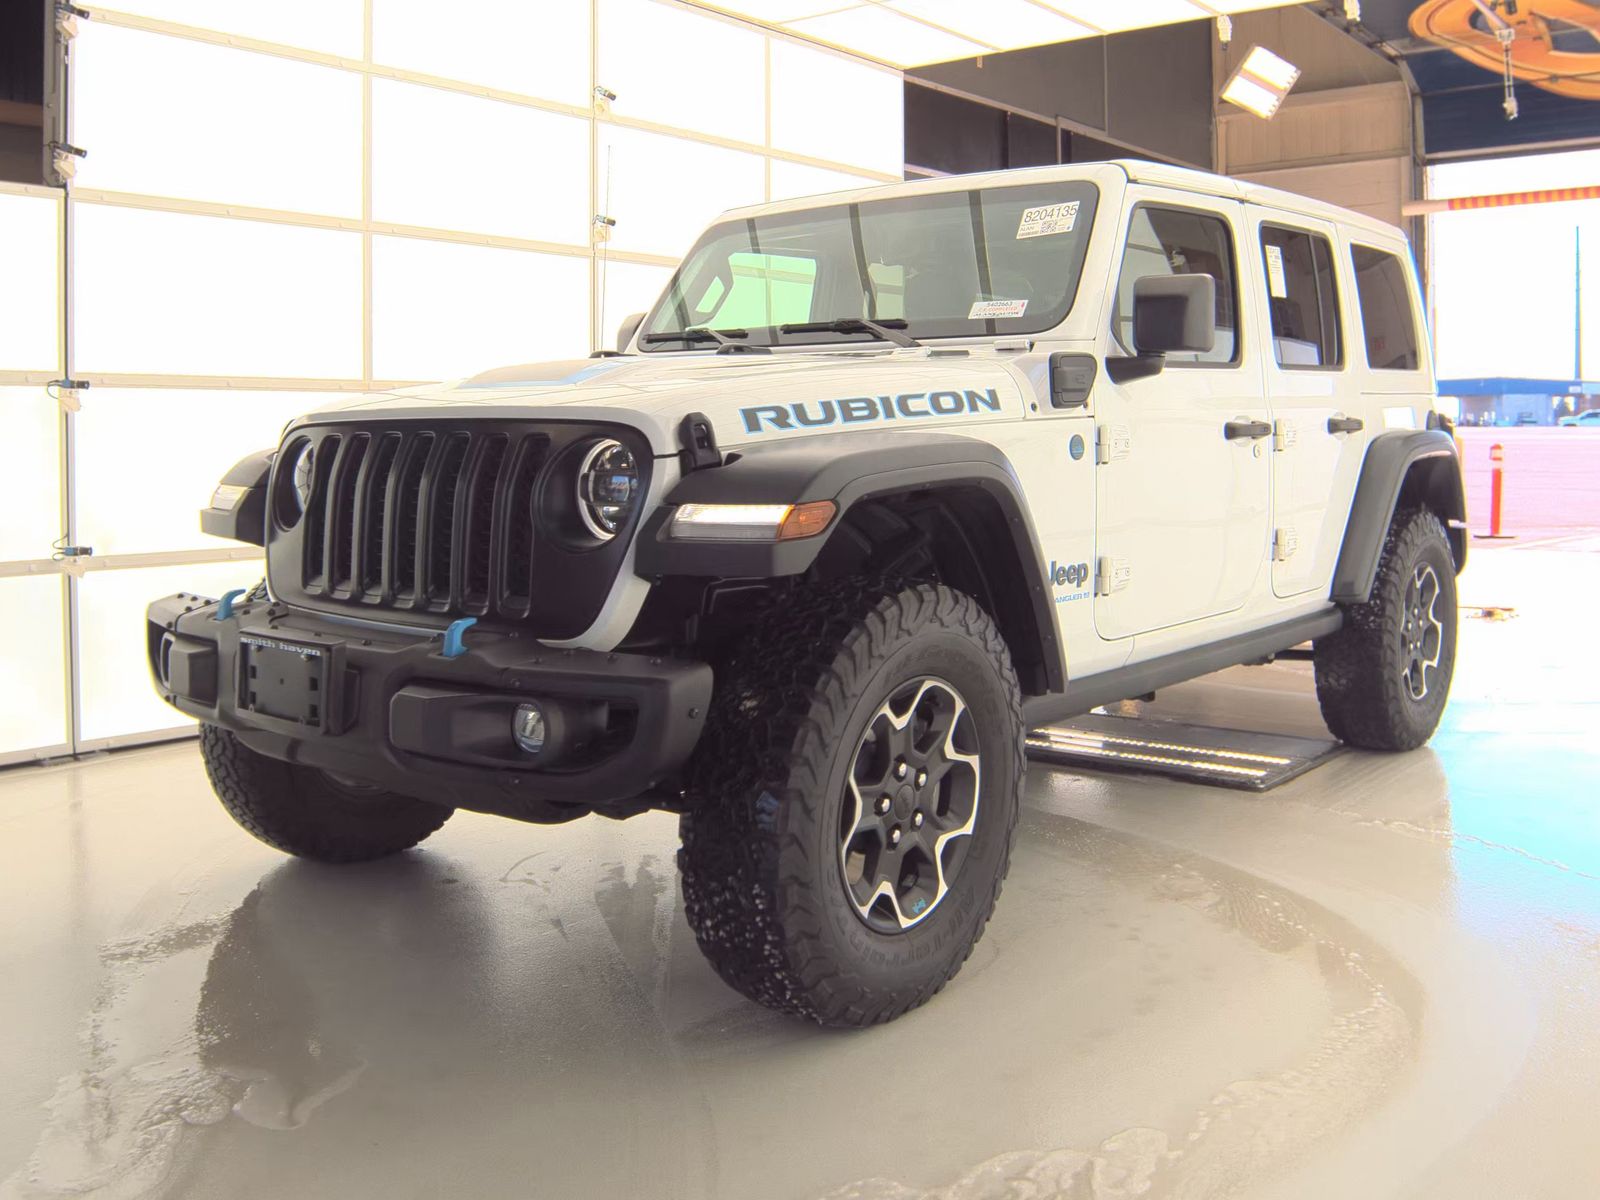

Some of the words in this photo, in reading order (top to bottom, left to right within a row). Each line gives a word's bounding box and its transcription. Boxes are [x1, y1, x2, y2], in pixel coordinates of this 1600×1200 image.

[1024, 204, 1077, 223] 8204135
[738, 388, 1001, 434] RUBICON
[1049, 560, 1088, 588] Jeep
[240, 637, 275, 648] smith
[280, 642, 320, 656] haven
